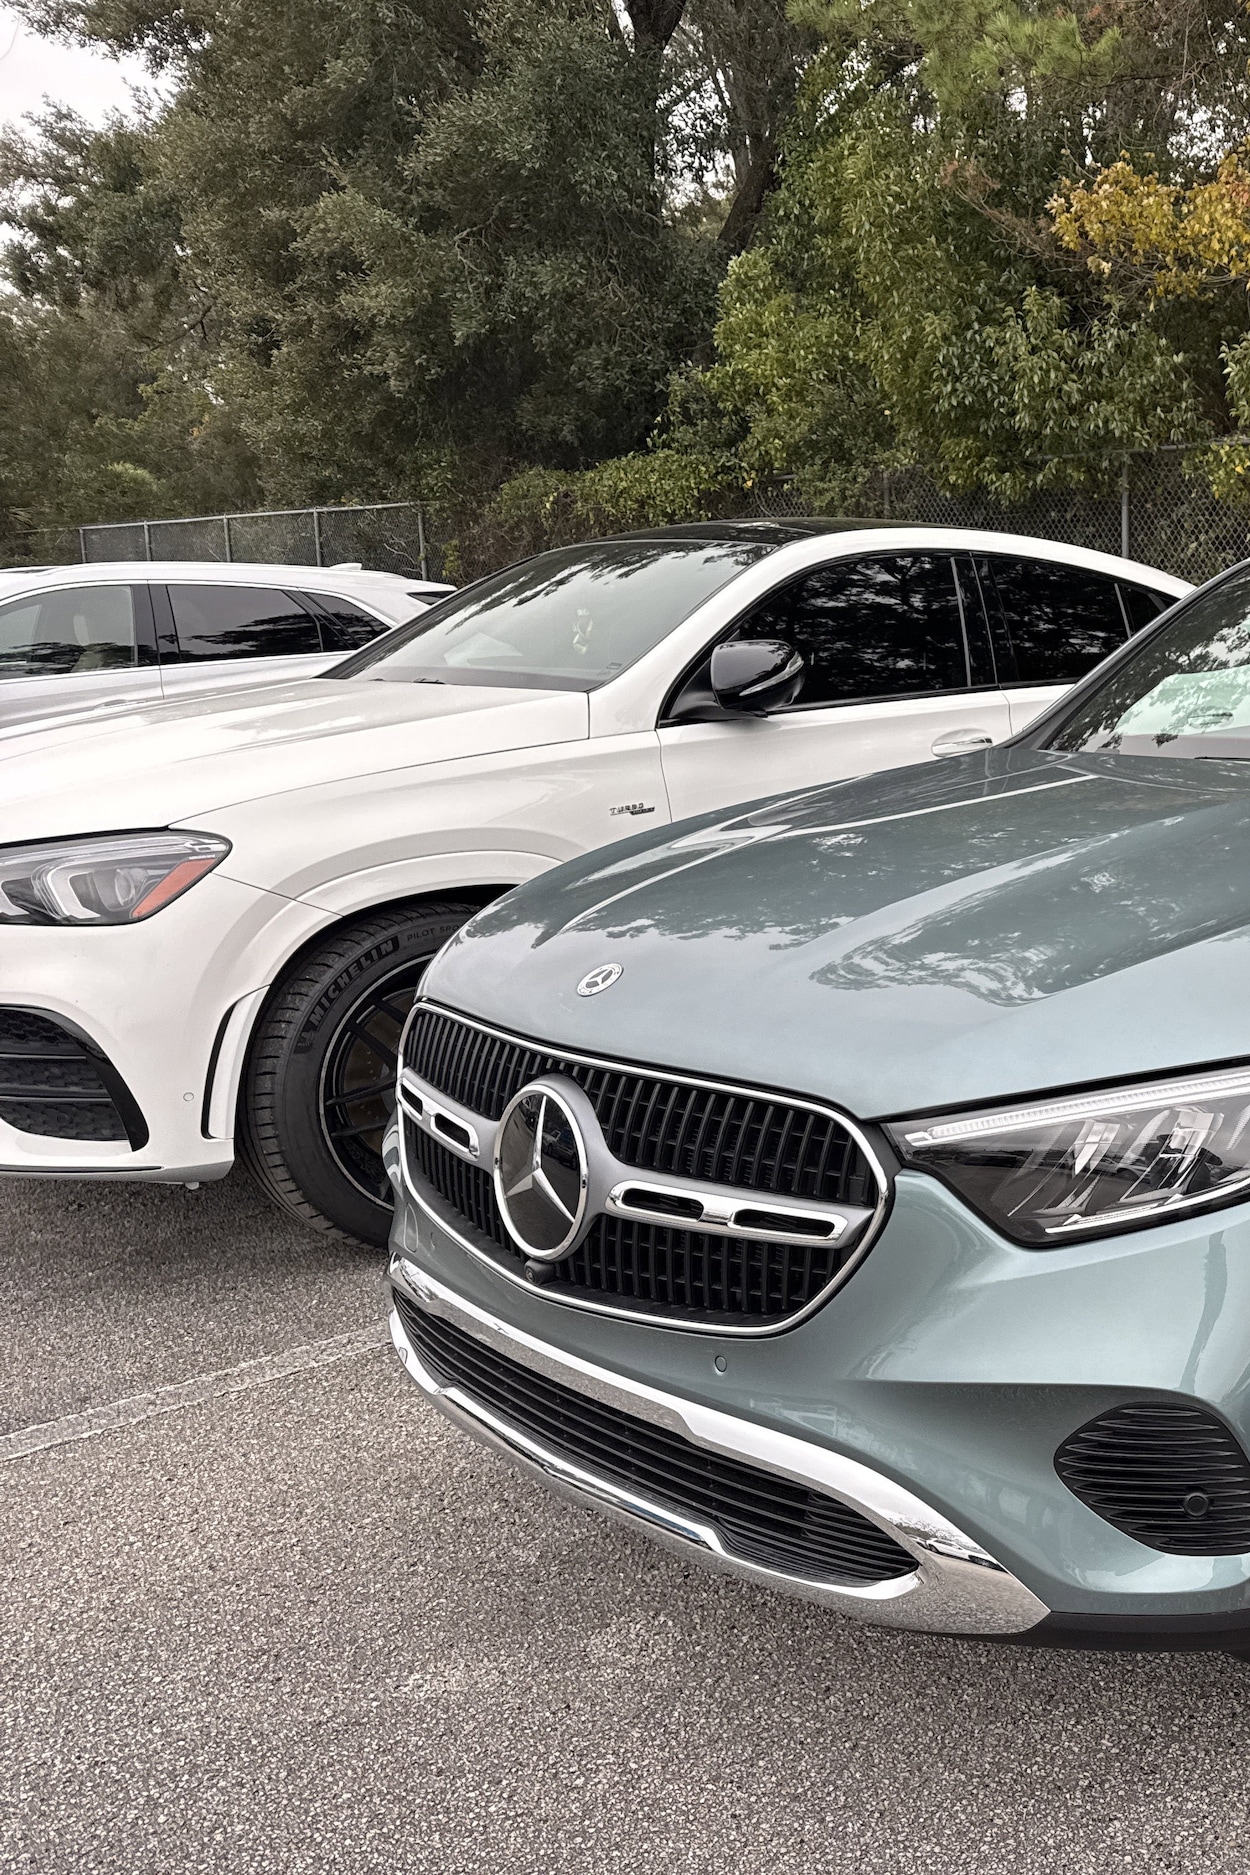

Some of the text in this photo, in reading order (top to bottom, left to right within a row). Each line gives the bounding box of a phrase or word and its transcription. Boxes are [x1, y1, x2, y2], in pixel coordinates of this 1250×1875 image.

[609, 802, 644, 814] TURBO
[406, 924, 460, 942] PILOT SPO
[308, 940, 394, 1026] MICHELIN
